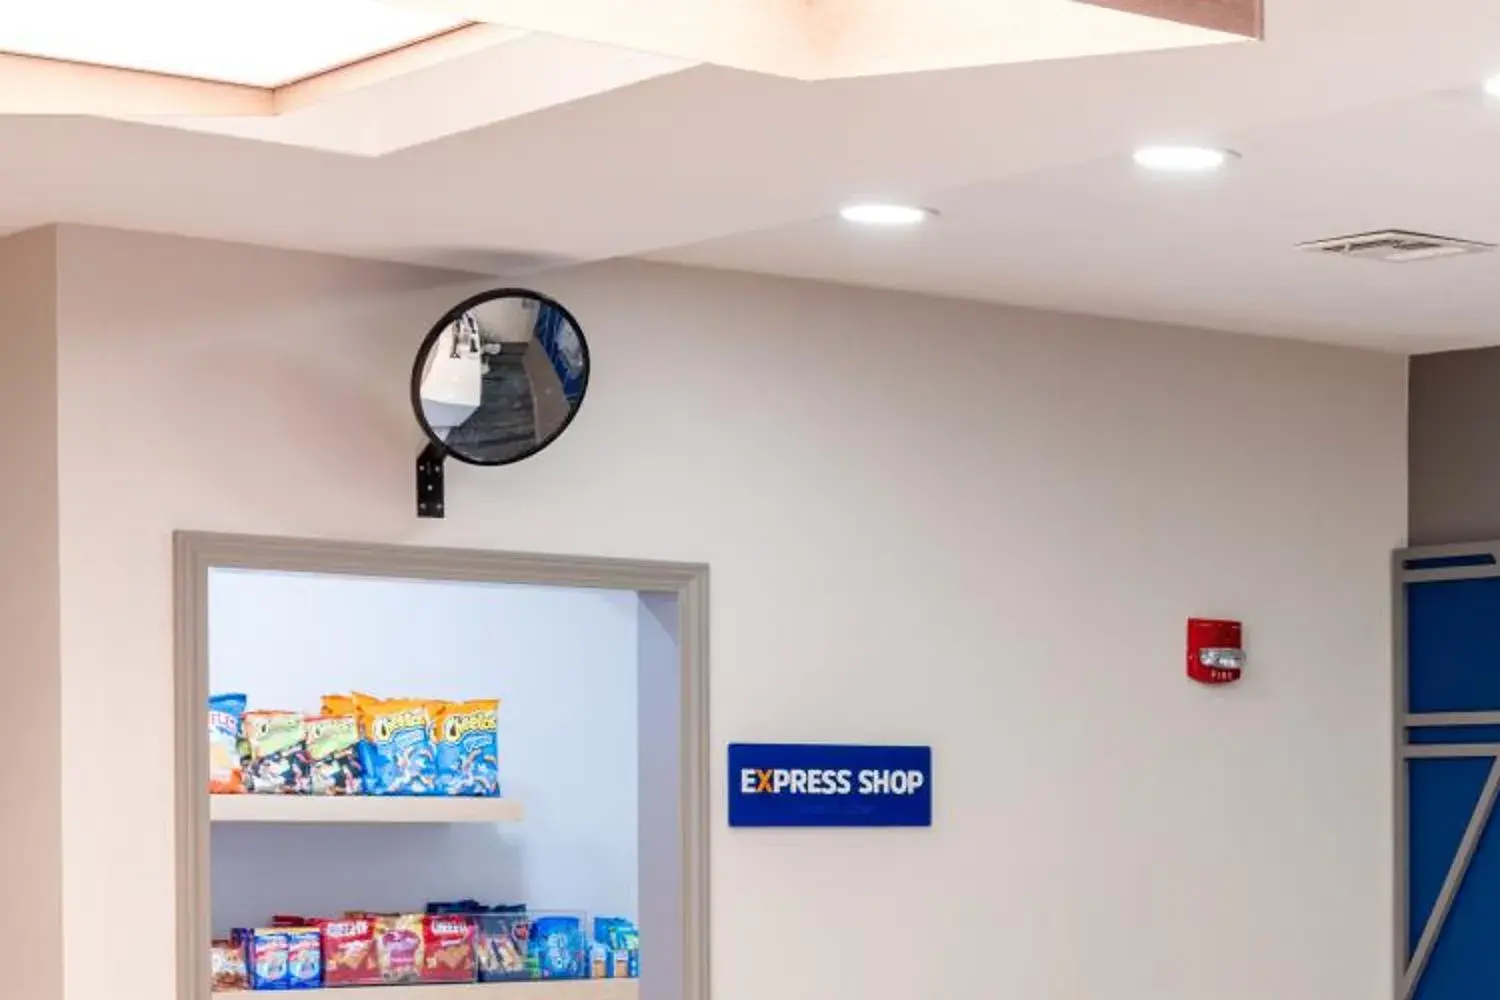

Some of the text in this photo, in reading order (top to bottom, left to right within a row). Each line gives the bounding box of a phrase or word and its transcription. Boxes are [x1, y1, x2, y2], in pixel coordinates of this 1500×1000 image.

[1210, 669, 1233, 681] FIRE
[741, 768, 924, 795] EXPRESS SHOP
